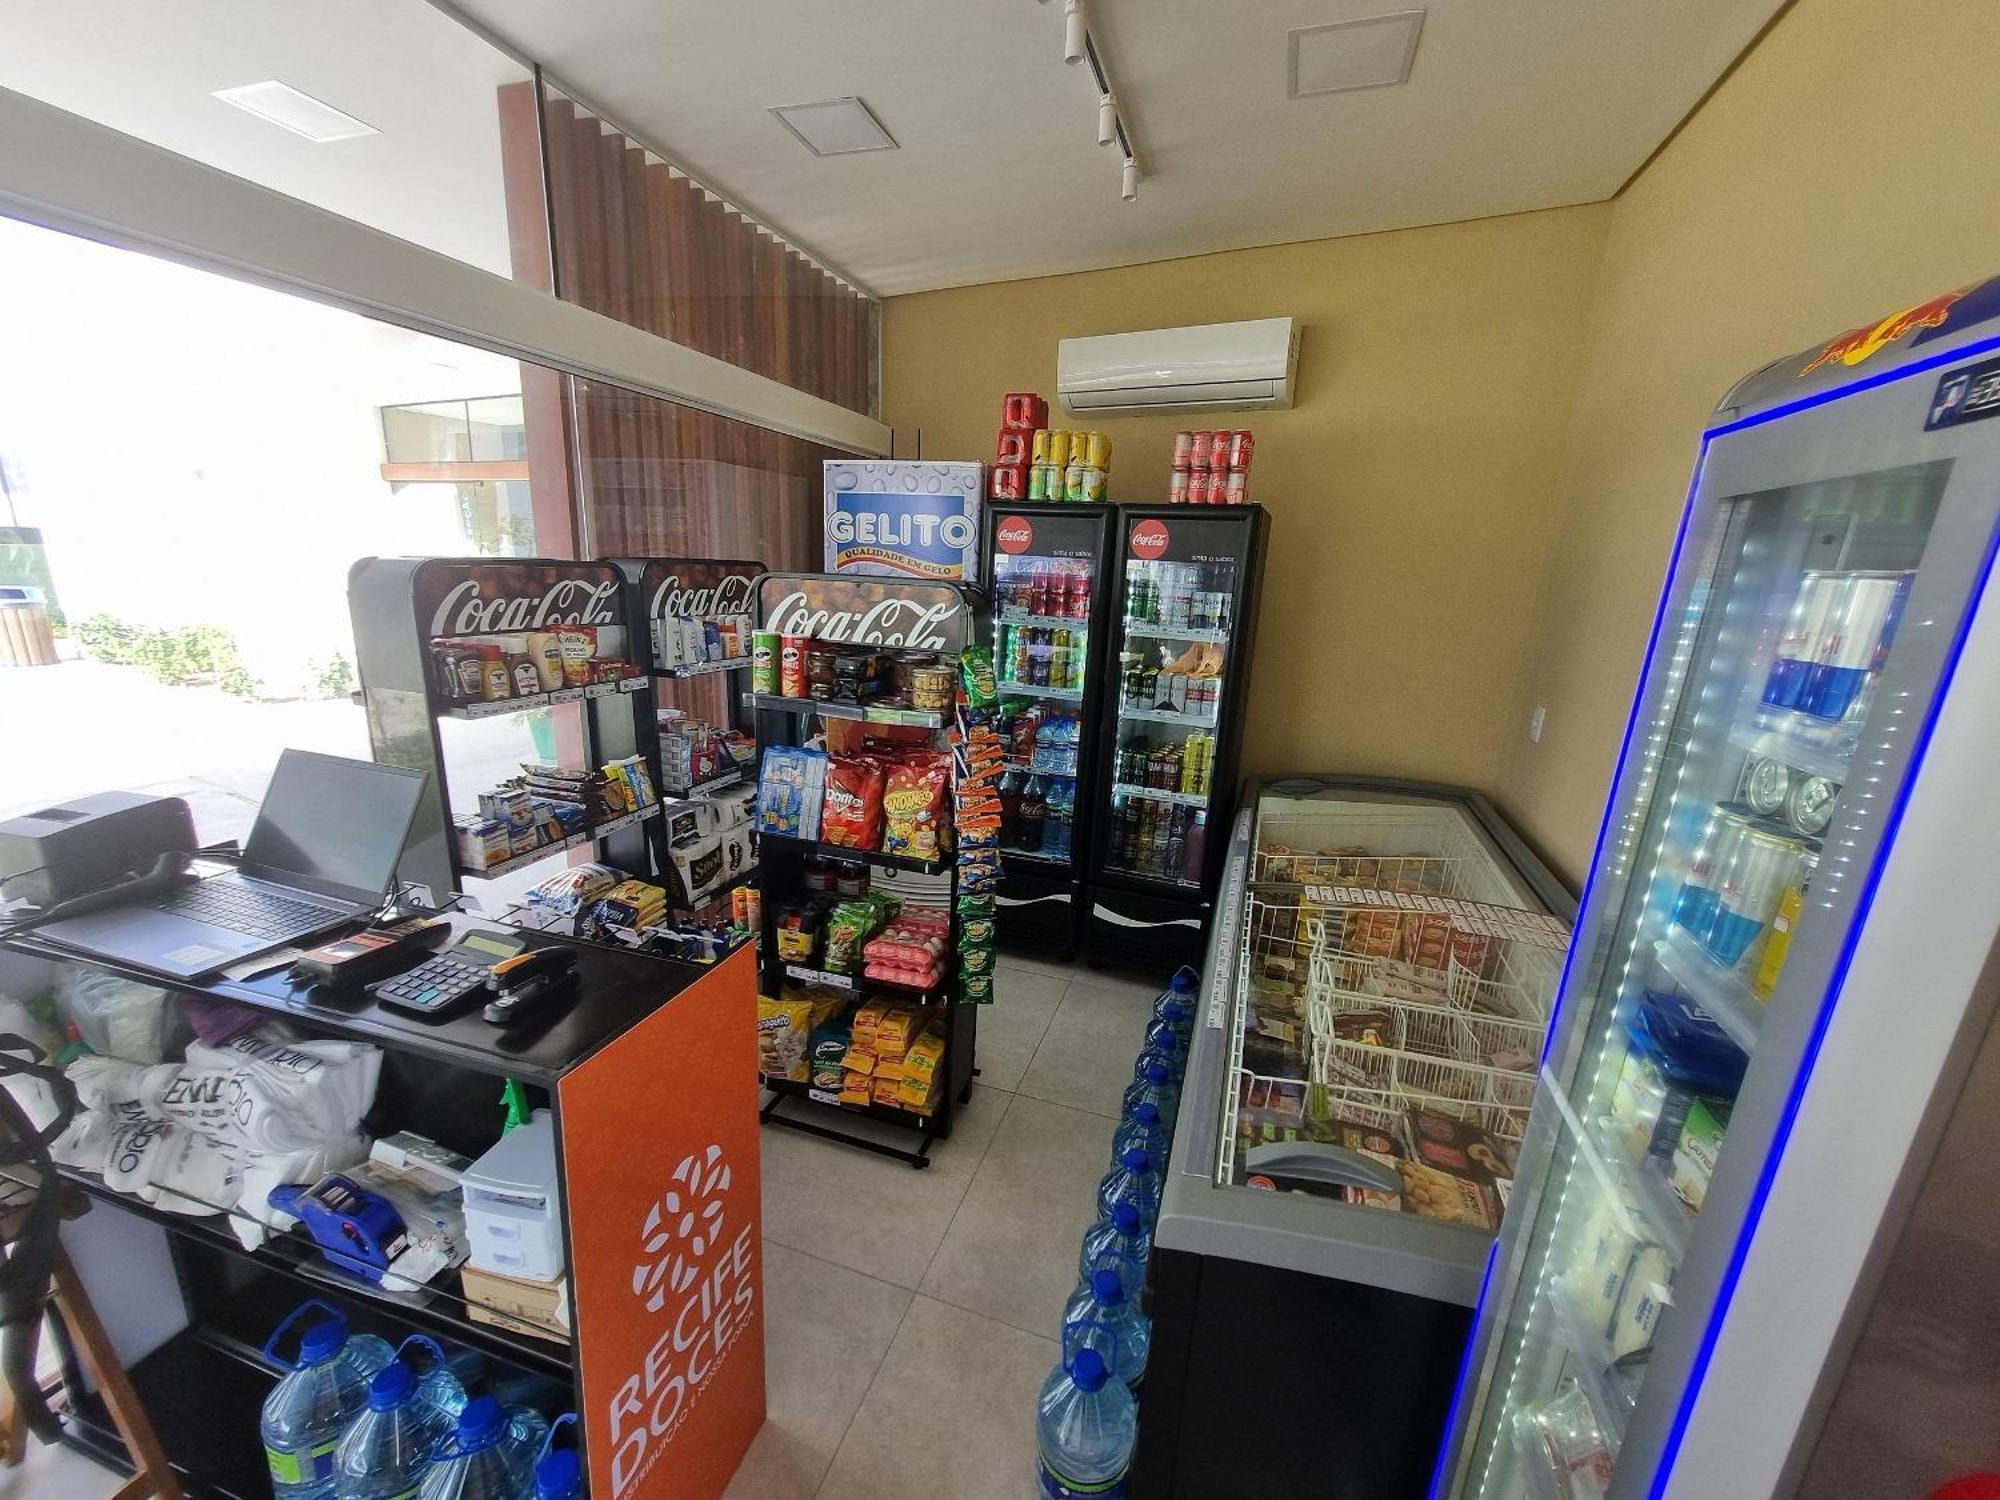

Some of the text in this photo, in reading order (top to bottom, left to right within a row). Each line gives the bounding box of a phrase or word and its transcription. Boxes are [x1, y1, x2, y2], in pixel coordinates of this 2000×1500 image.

[827, 511, 977, 550] GELITO
[998, 529, 1030, 542] Coca-Cola
[1132, 533, 1169, 547] Coca-Cola
[844, 547, 952, 576] QUALIDADE EM GELO
[431, 580, 620, 636] Coca-Cola
[651, 576, 753, 619] Coca-Col
[766, 592, 961, 650] Coca-Cola
[610, 1222, 752, 1447] RECIFE
[612, 1271, 753, 1500] DOCES
